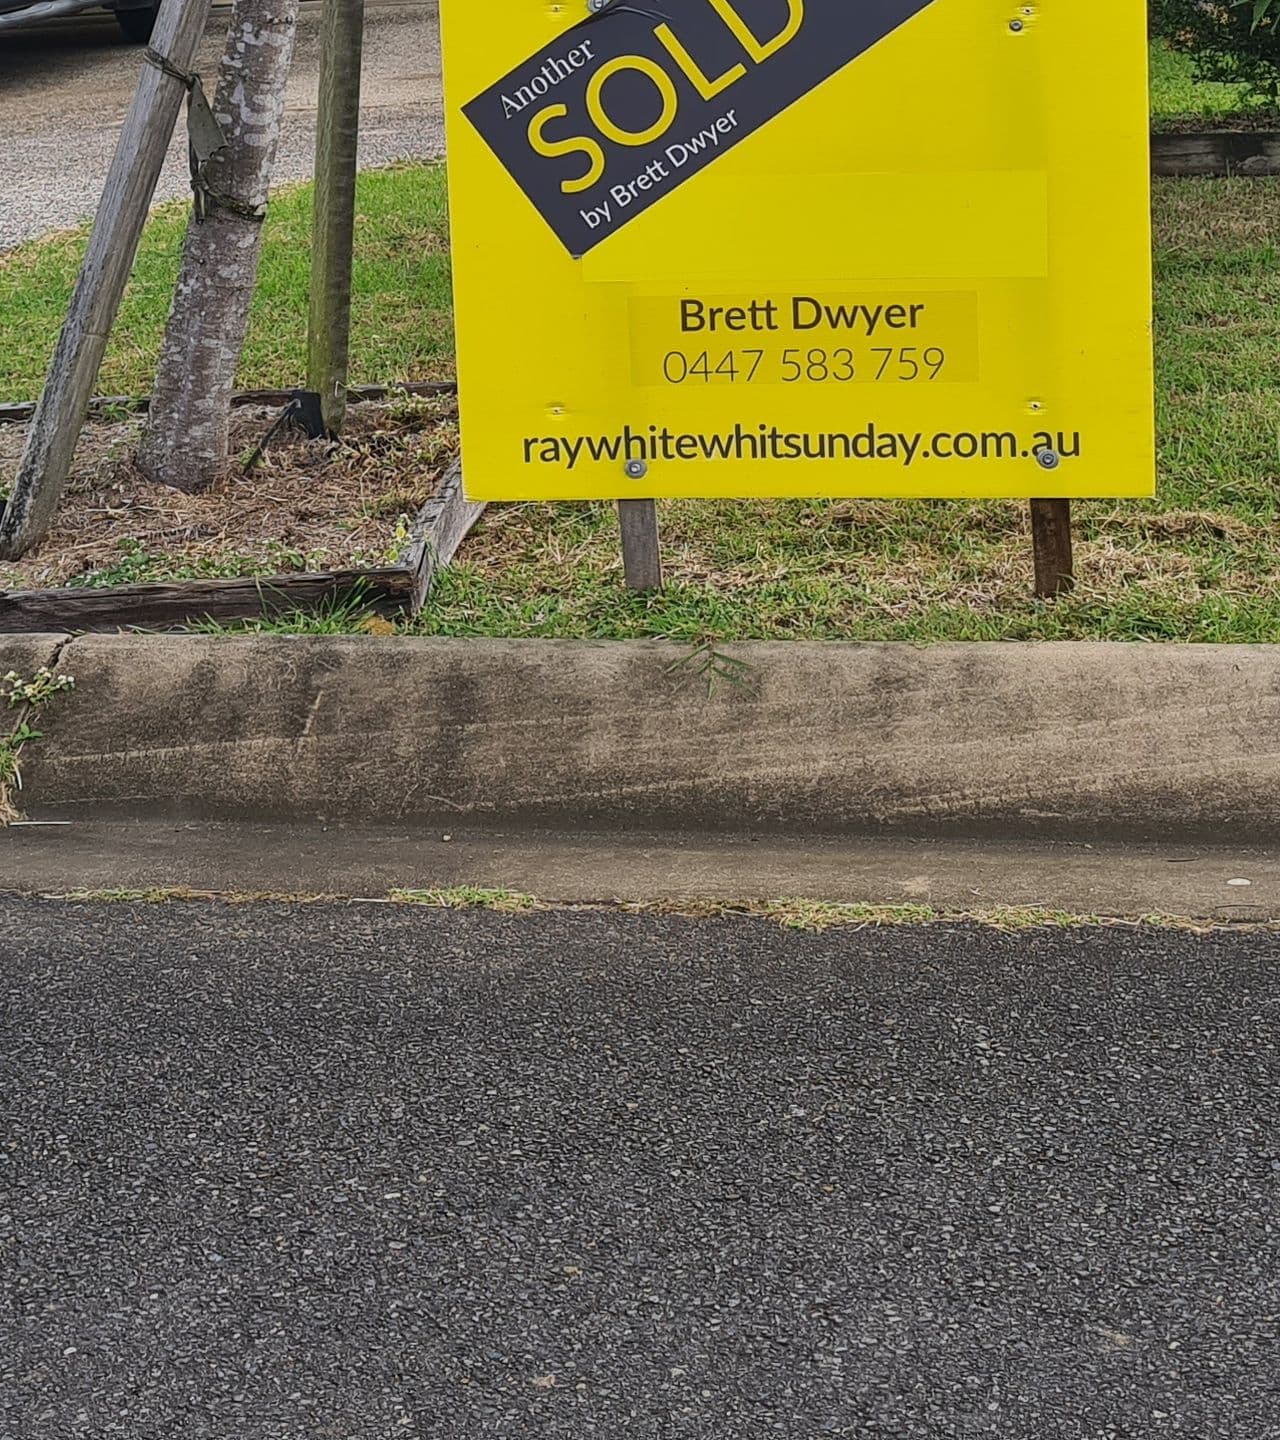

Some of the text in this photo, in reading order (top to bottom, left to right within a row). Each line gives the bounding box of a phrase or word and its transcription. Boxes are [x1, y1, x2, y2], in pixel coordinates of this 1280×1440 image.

[499, 39, 595, 119] Another
[579, 109, 739, 229] by Brett Dwyer
[680, 297, 925, 336] Brett Dwyer
[663, 347, 945, 383] 0447 583 759
[523, 423, 1080, 469] raywhitewhitsunday.com.au
